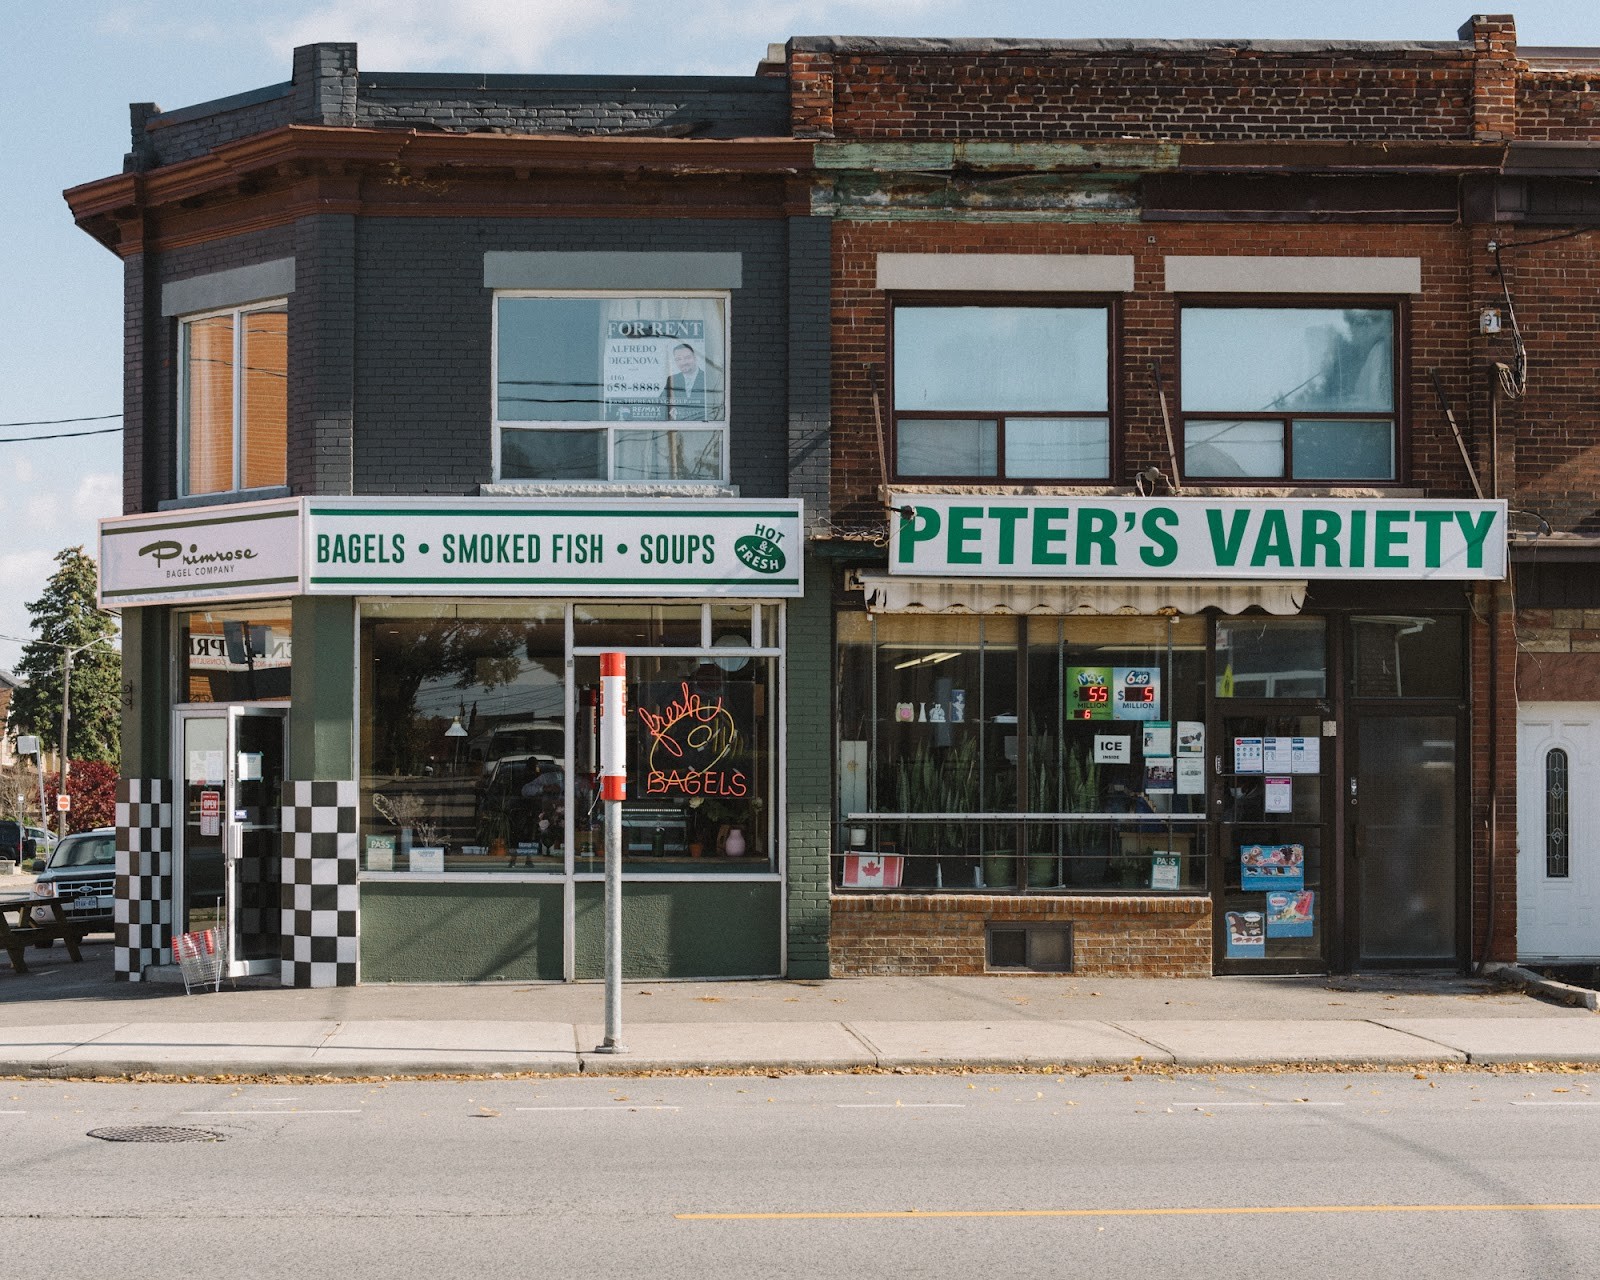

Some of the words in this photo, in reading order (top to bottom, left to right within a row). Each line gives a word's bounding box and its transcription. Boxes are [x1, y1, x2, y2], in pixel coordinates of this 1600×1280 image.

[608, 322, 645, 336] FOR
[652, 322, 702, 336] RENT
[610, 345, 657, 353] ALFREDO
[607, 383, 660, 392] 658-8888
[755, 524, 785, 543] HOT
[899, 507, 1179, 567] PETER'S
[1206, 509, 1497, 568] VARIETY
[318, 534, 404, 563] BAGELS
[443, 534, 540, 563] SMOKED
[553, 534, 602, 563] FISH
[641, 535, 714, 564] SOUPS
[759, 541, 768, 551] &
[139, 539, 258, 568] Primrose
[737, 544, 779, 570] FRESH
[166, 568, 192, 579] BAGEL
[195, 565, 235, 577] COMPANY
[1089, 686, 1108, 702] 55
[1117, 691, 1125, 701] $
[1144, 687, 1154, 702] 5
[1084, 709, 1091, 719] 6
[1101, 742, 1122, 751] ICE
[647, 770, 747, 796] BAGELS
[203, 800, 217, 809] OPEN
[371, 840, 390, 849] PASS
